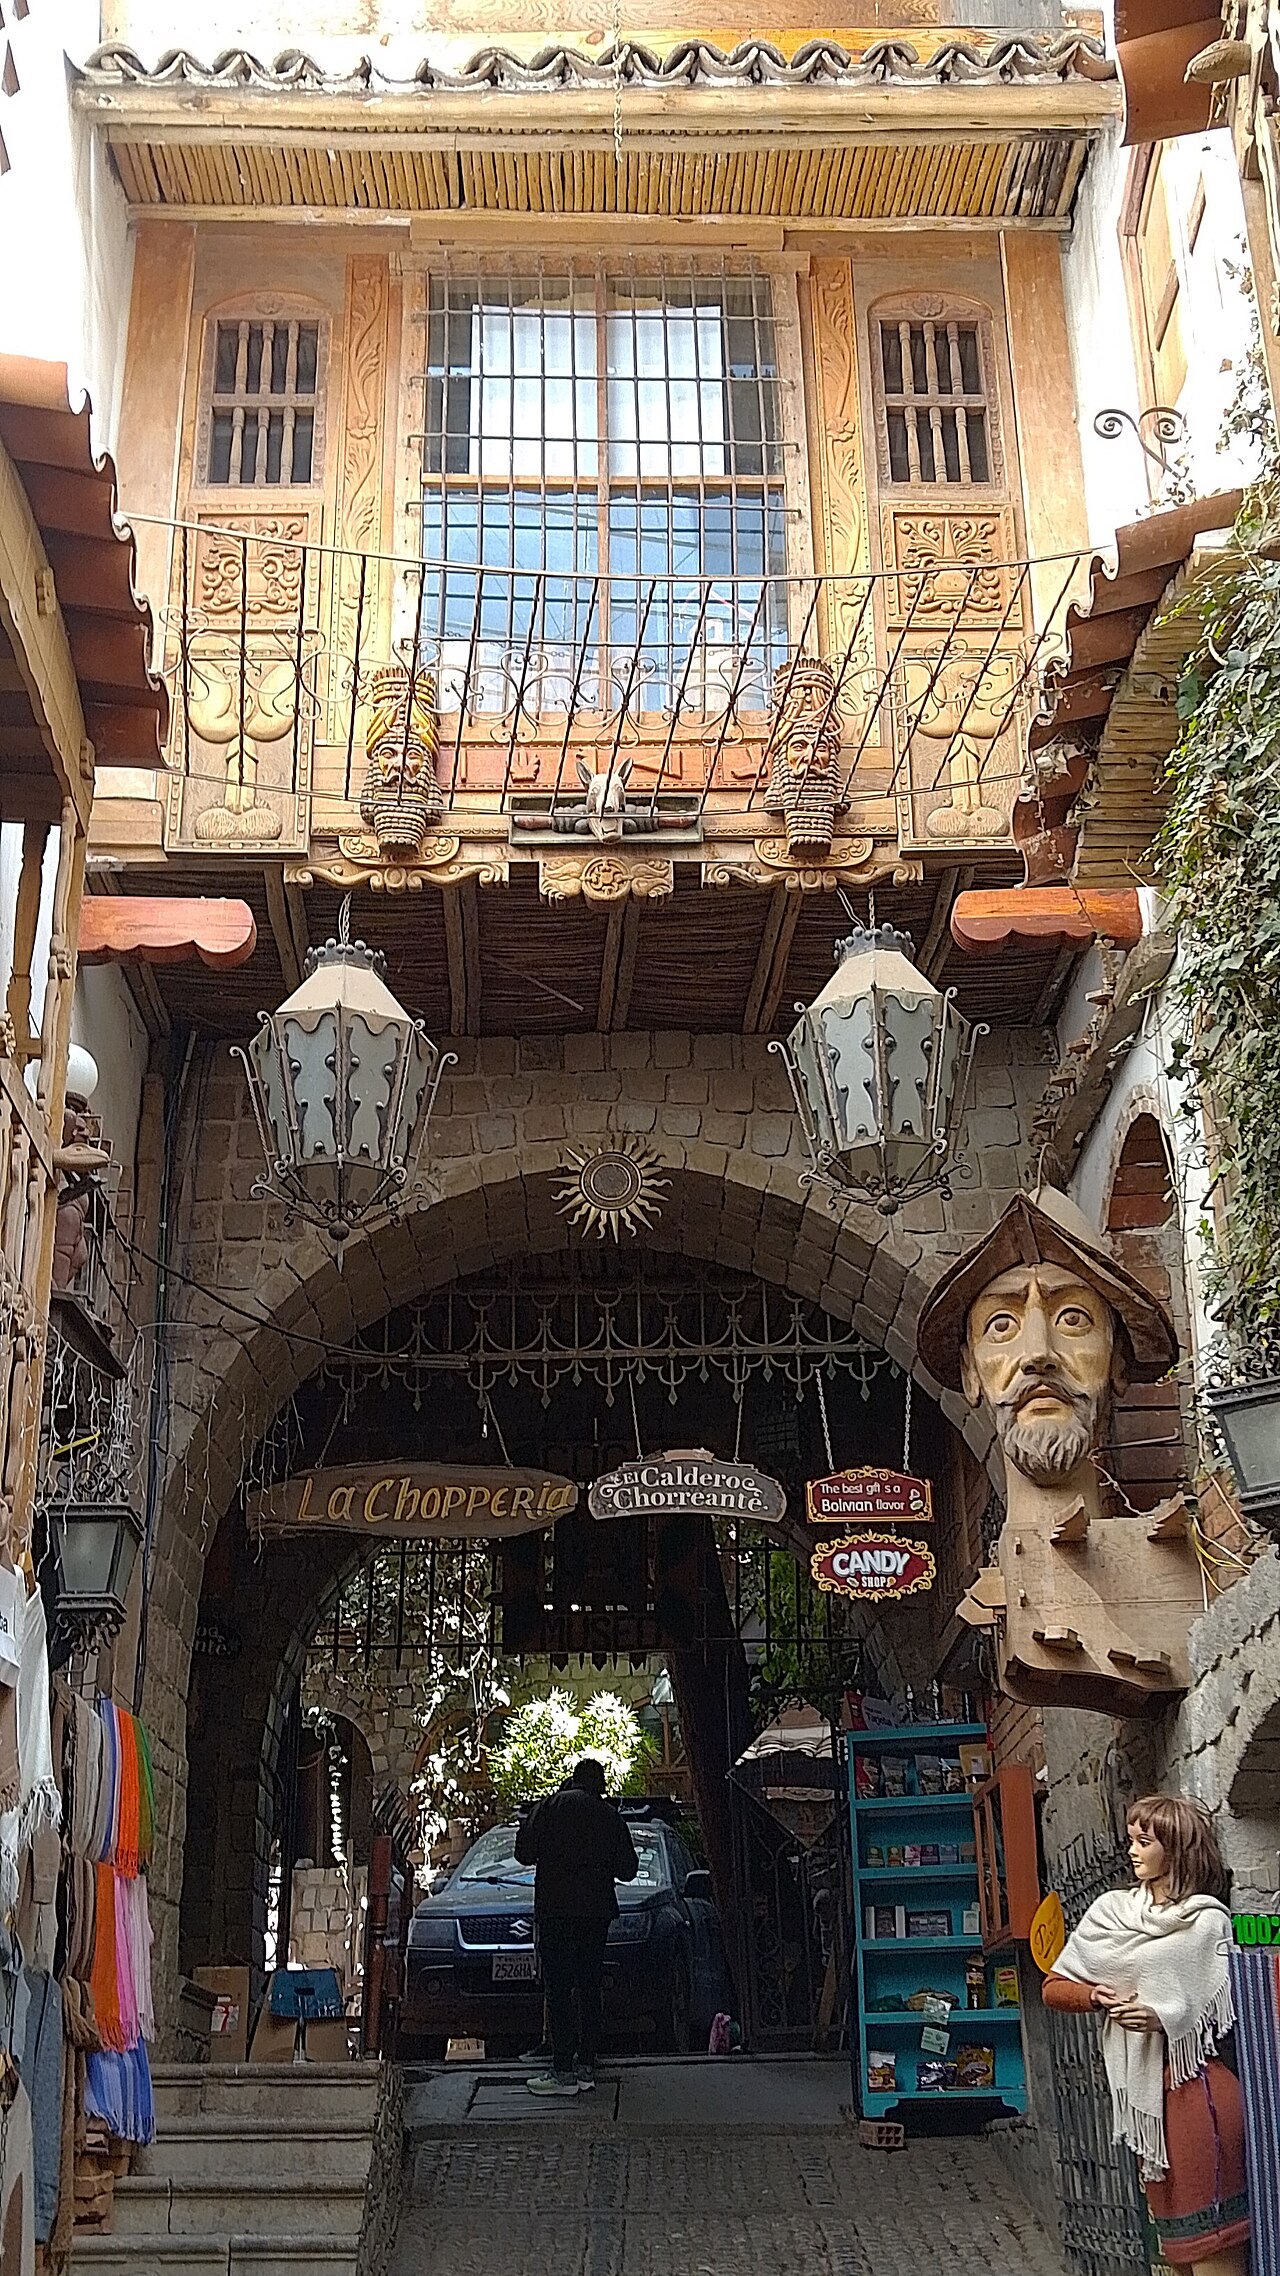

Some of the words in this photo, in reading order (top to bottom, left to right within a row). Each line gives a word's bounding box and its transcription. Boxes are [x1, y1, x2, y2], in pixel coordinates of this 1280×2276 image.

[640, 1466, 741, 1489] Caldero
[820, 1483, 840, 1494] The
[842, 1482, 863, 1494] best
[893, 1485, 901, 1494] a
[297, 1477, 358, 1522] La
[613, 1486, 763, 1513] Chorreante
[821, 1498, 873, 1512] Bolivian
[875, 1499, 905, 1511] flavor
[832, 1549, 911, 1578] CANDY
[861, 1576, 886, 1588] SHOP
